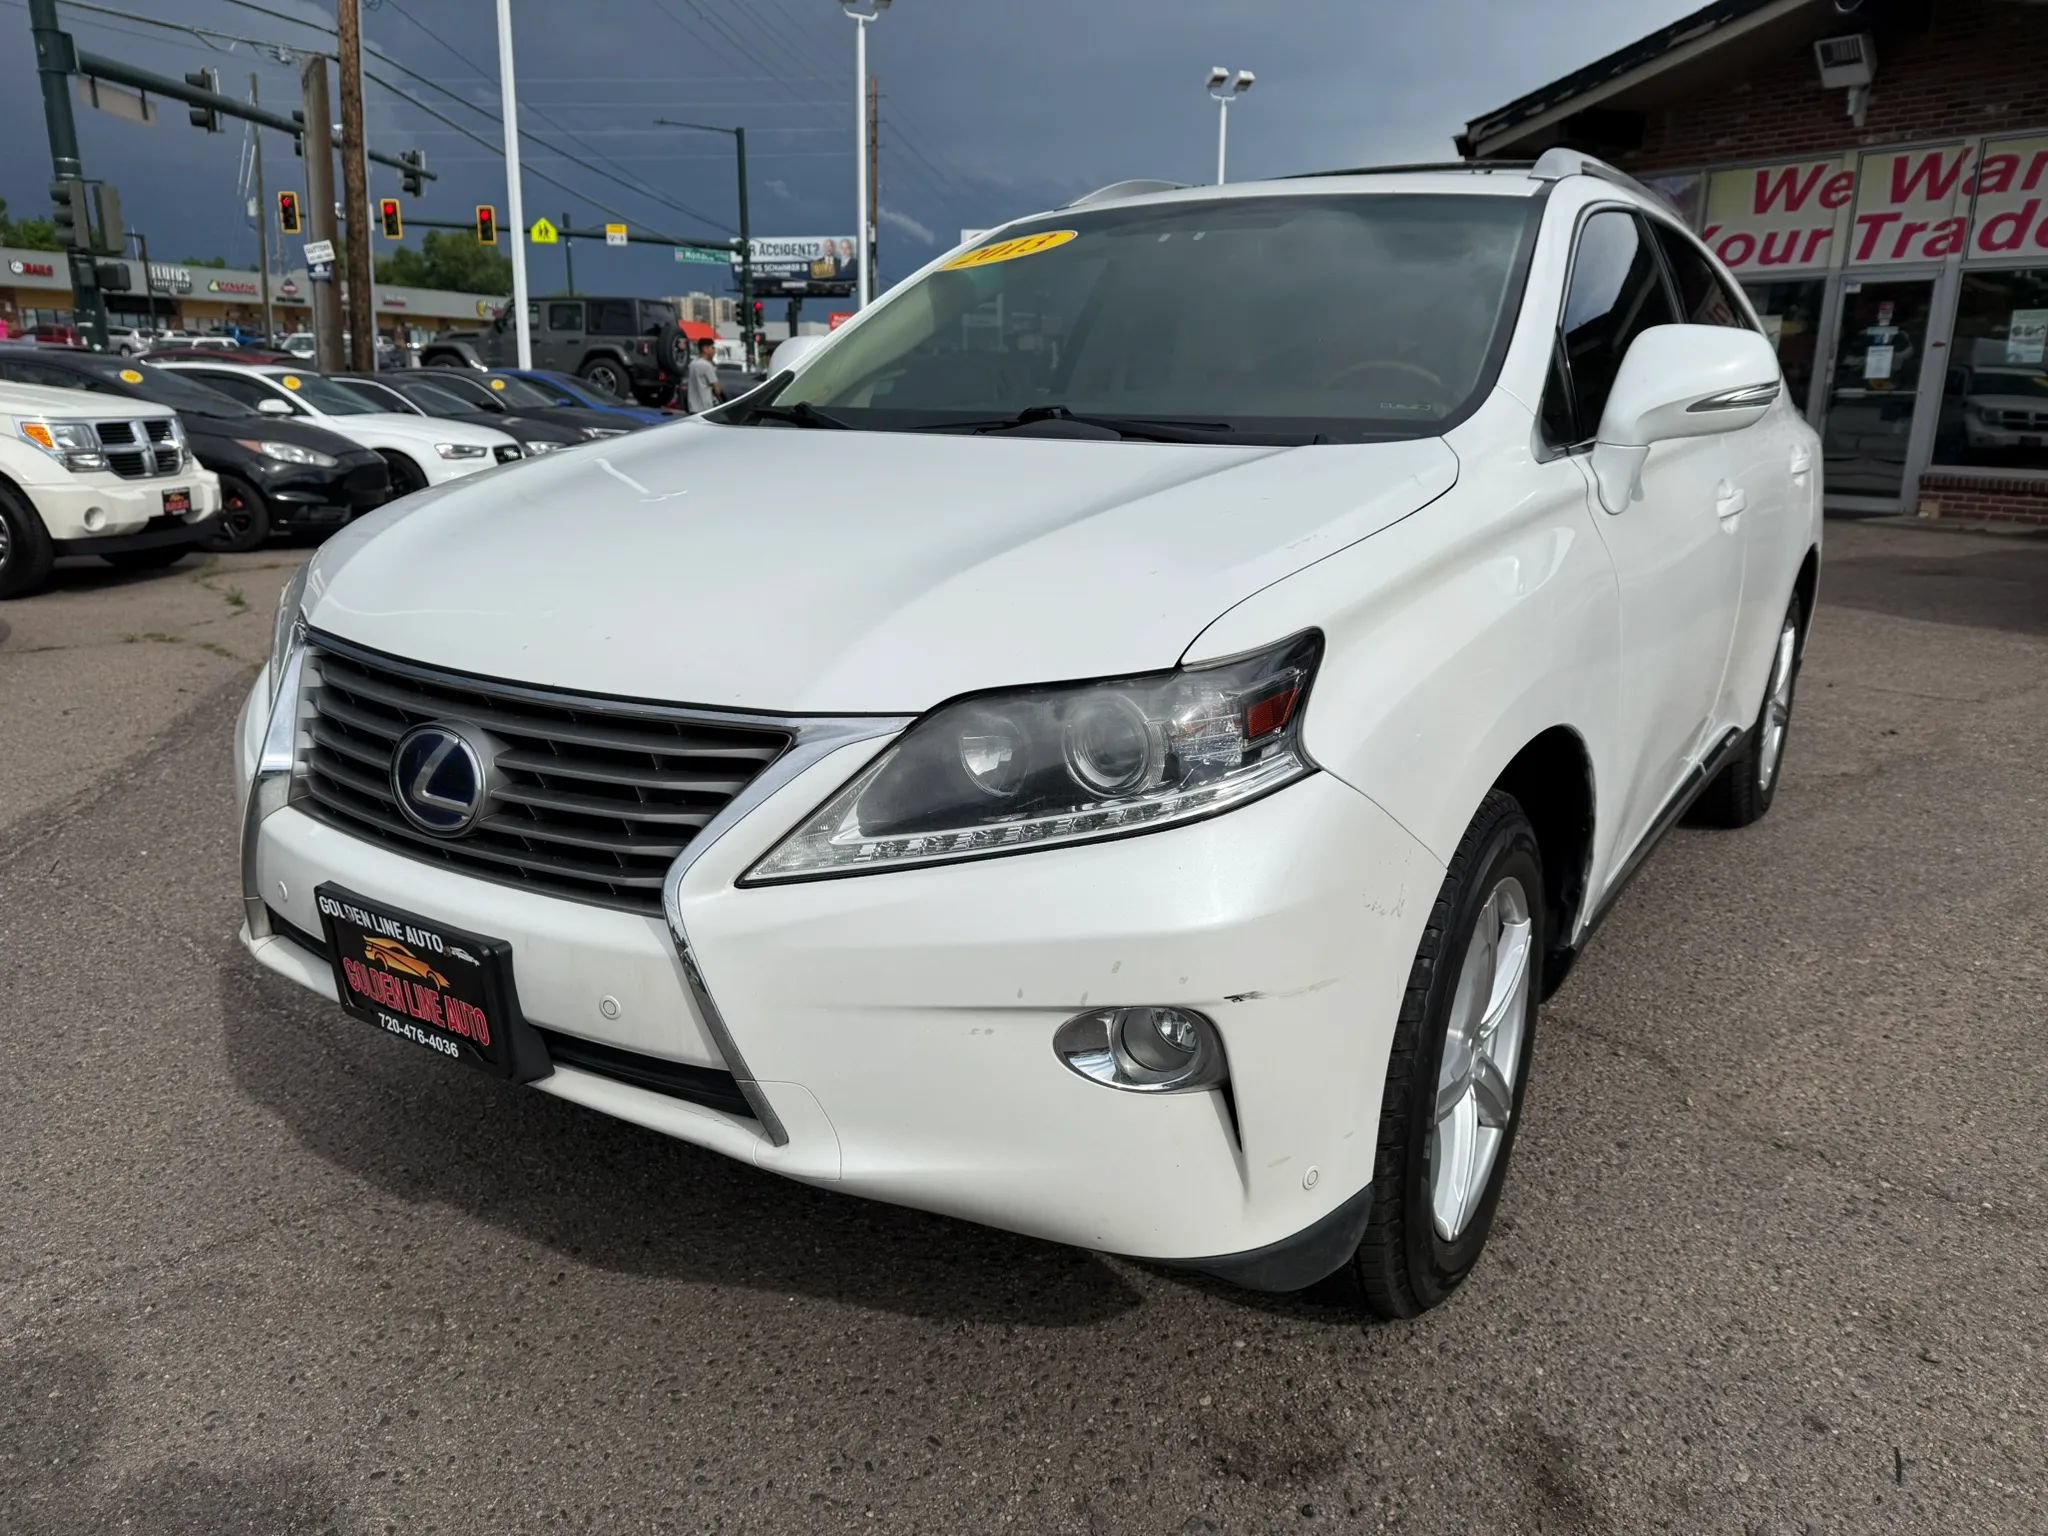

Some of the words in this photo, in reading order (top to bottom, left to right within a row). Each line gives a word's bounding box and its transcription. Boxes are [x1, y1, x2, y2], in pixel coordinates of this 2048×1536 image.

[1752, 163, 1856, 215] We
[759, 242, 820, 257] ACCIDENT?
[319, 895, 373, 929] GOLDEN
[372, 914, 405, 940] LINE
[405, 926, 444, 954] AUTO
[342, 957, 408, 1014] GOLDEN
[403, 979, 446, 1028] LINE
[444, 995, 490, 1047] AUTO
[378, 1012, 459, 1058] 720-476-4036
